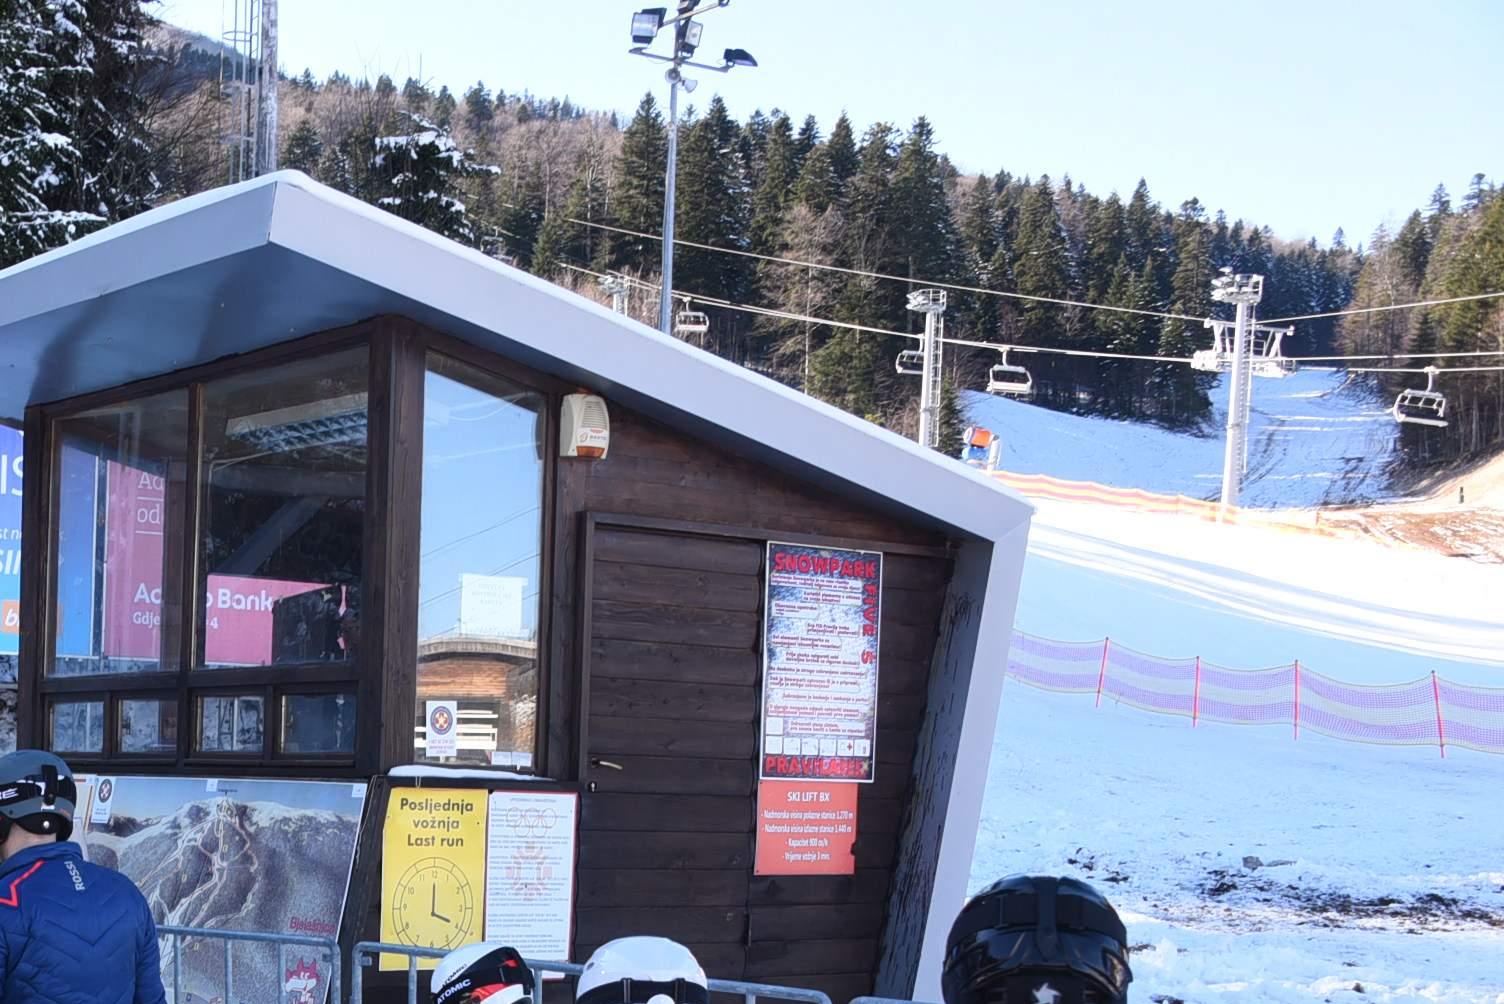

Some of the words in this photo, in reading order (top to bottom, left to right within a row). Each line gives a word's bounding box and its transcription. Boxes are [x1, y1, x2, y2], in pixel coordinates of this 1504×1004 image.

[773, 551, 877, 579] SNOWPARK
[218, 588, 273, 611] Bank
[862, 583, 877, 636] FIVE
[787, 791, 801, 802] SKI
[802, 791, 818, 802] LIFT
[399, 797, 474, 816] Posljednja
[412, 816, 460, 833] vožnja
[407, 834, 436, 847] Last
[440, 835, 464, 847] run
[63, 860, 86, 891] ROSSI
[430, 870, 439, 880] 12
[406, 886, 415, 896] 10
